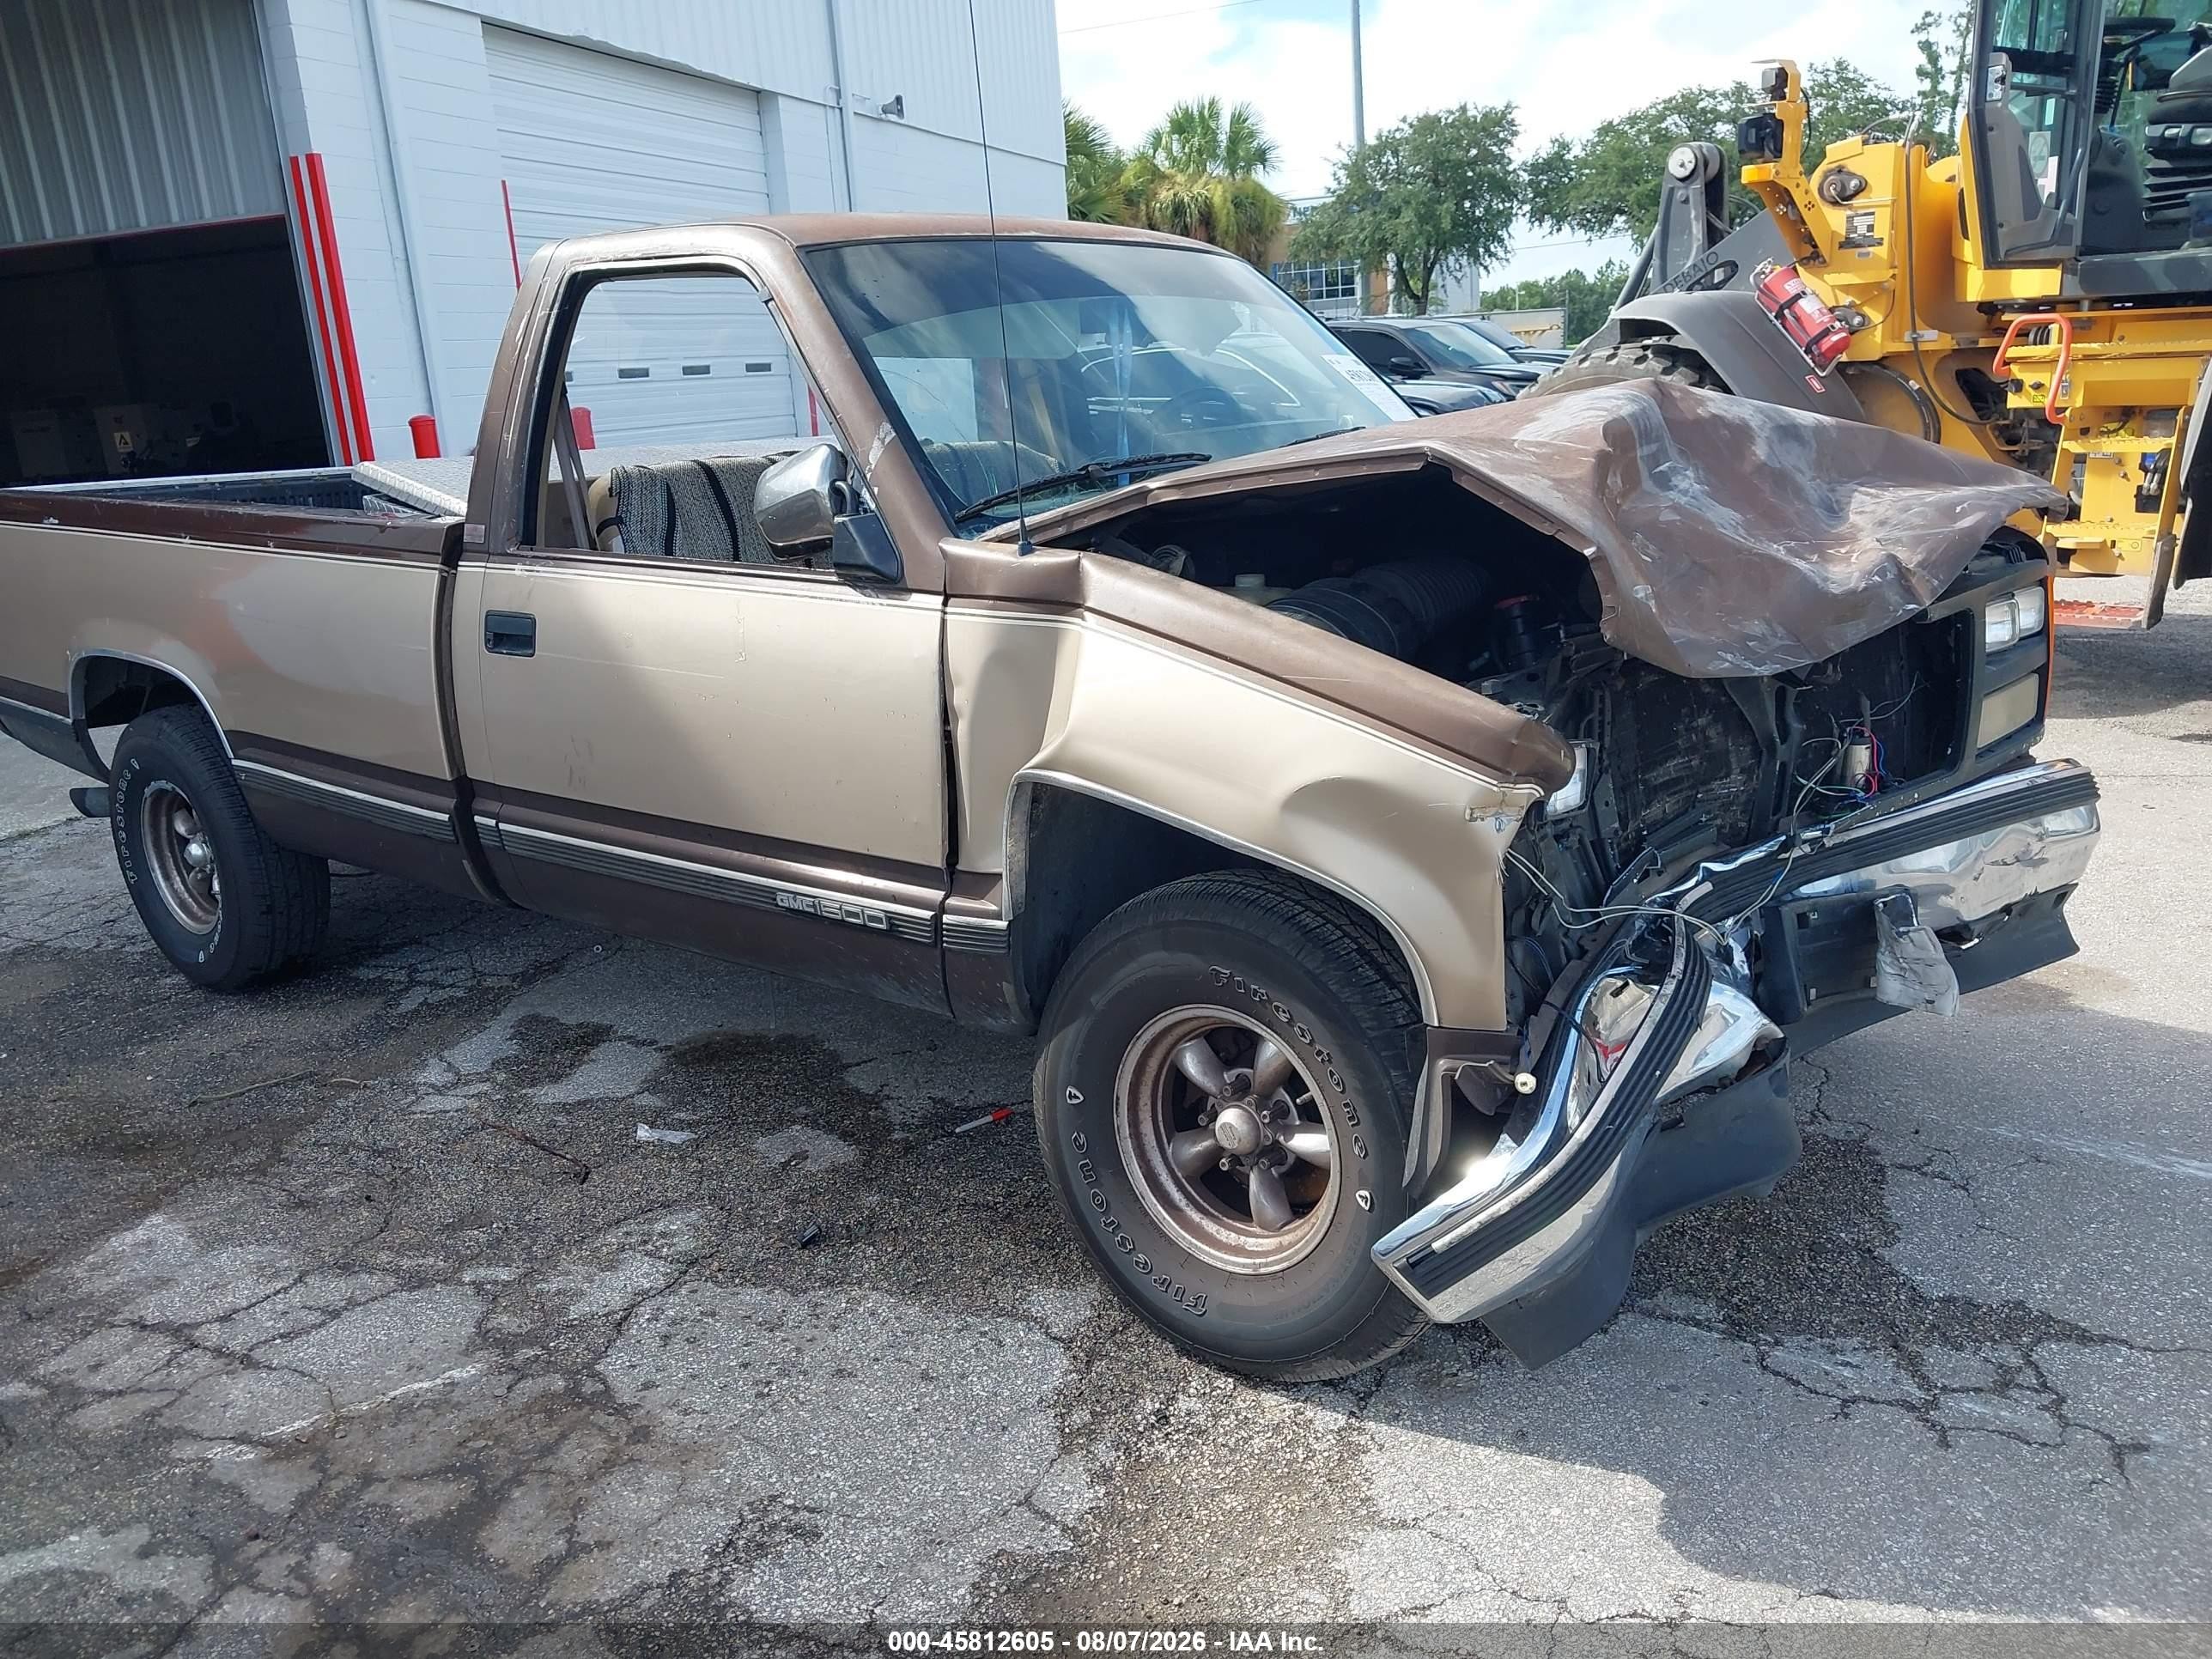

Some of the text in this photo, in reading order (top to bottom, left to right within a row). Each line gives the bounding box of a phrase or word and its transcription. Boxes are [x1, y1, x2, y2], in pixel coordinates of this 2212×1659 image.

[115, 769, 138, 885] Firestone
[1208, 964, 1370, 1160] Firestone
[1071, 1130, 1208, 1316] Firestone
